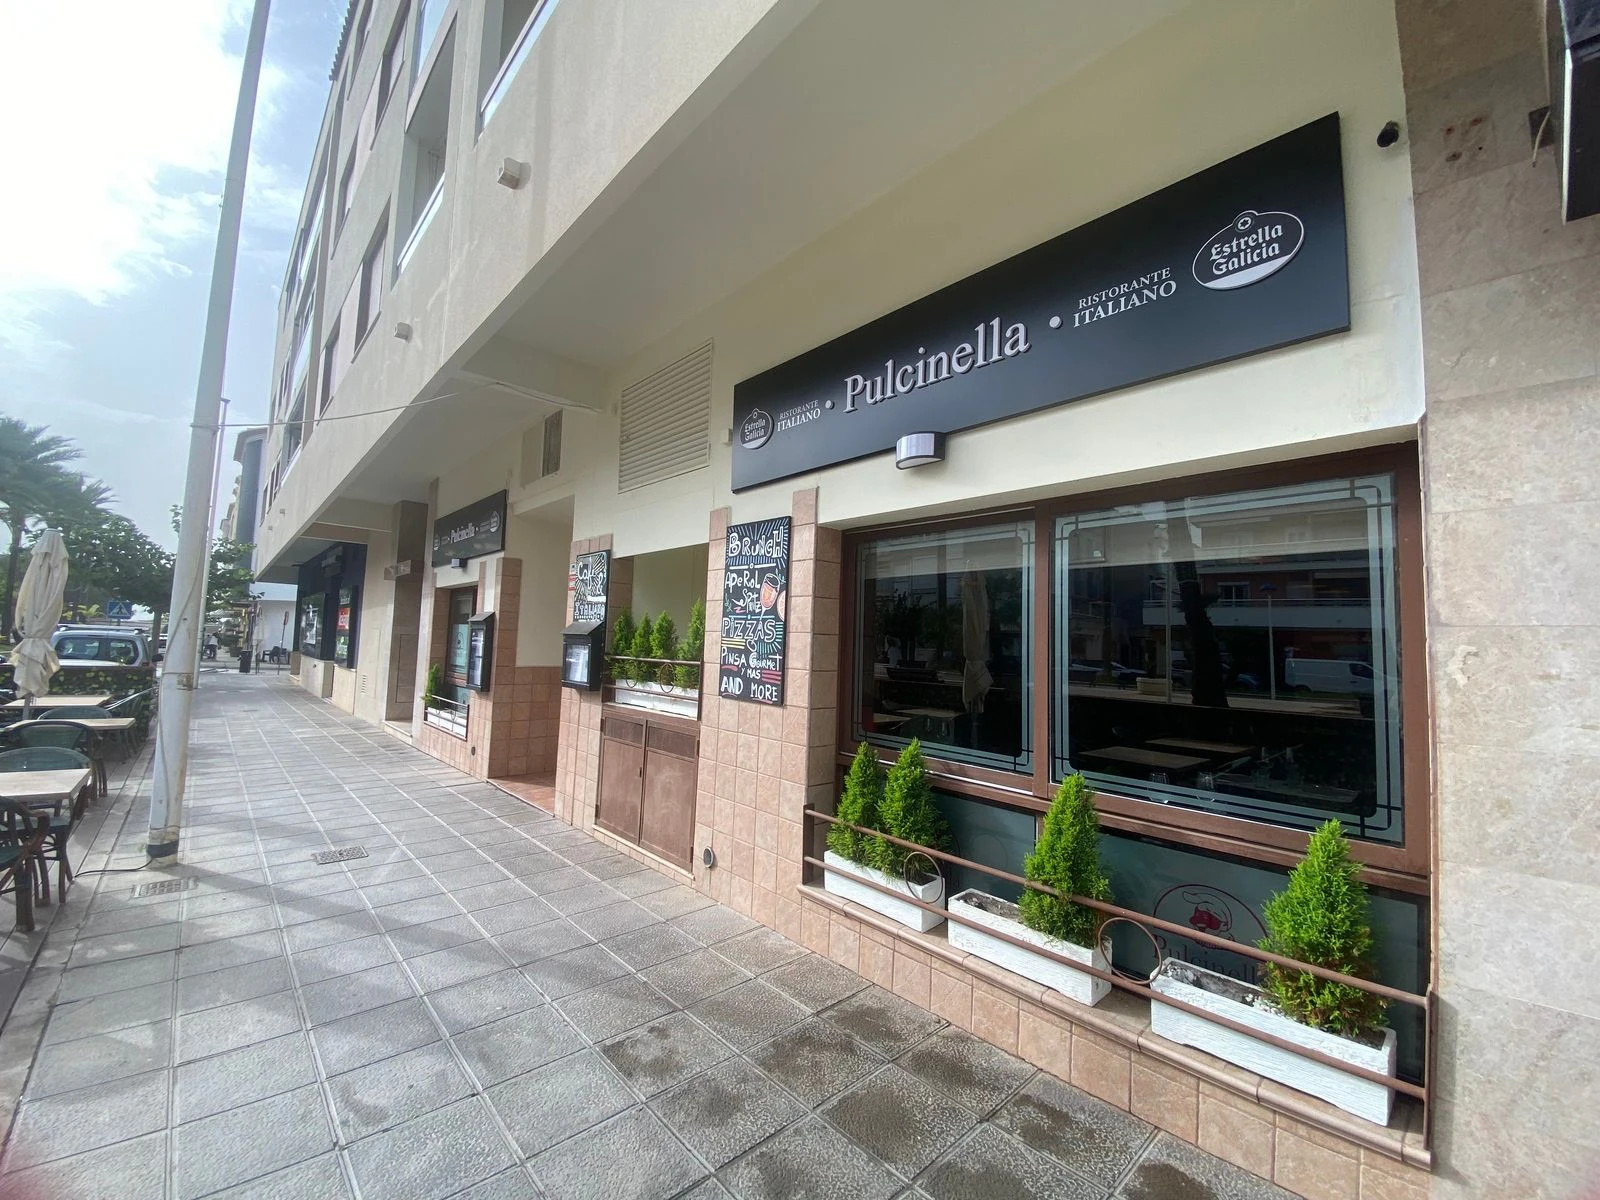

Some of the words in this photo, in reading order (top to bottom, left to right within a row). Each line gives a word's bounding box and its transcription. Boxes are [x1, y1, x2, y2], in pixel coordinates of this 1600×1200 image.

[1210, 224, 1283, 261] Estrella
[1212, 243, 1280, 275] Galicia
[1078, 267, 1171, 309] RISTORANTE
[1073, 280, 1177, 328] ITALIANO
[843, 316, 1031, 413] Pulcinella
[777, 408, 821, 432] ITALIANO
[780, 400, 818, 419] RISTORANTE
[744, 419, 766, 432] Estrella
[744, 428, 765, 441] Galicia
[720, 675, 744, 695] AND
[750, 682, 778, 701] MORE
